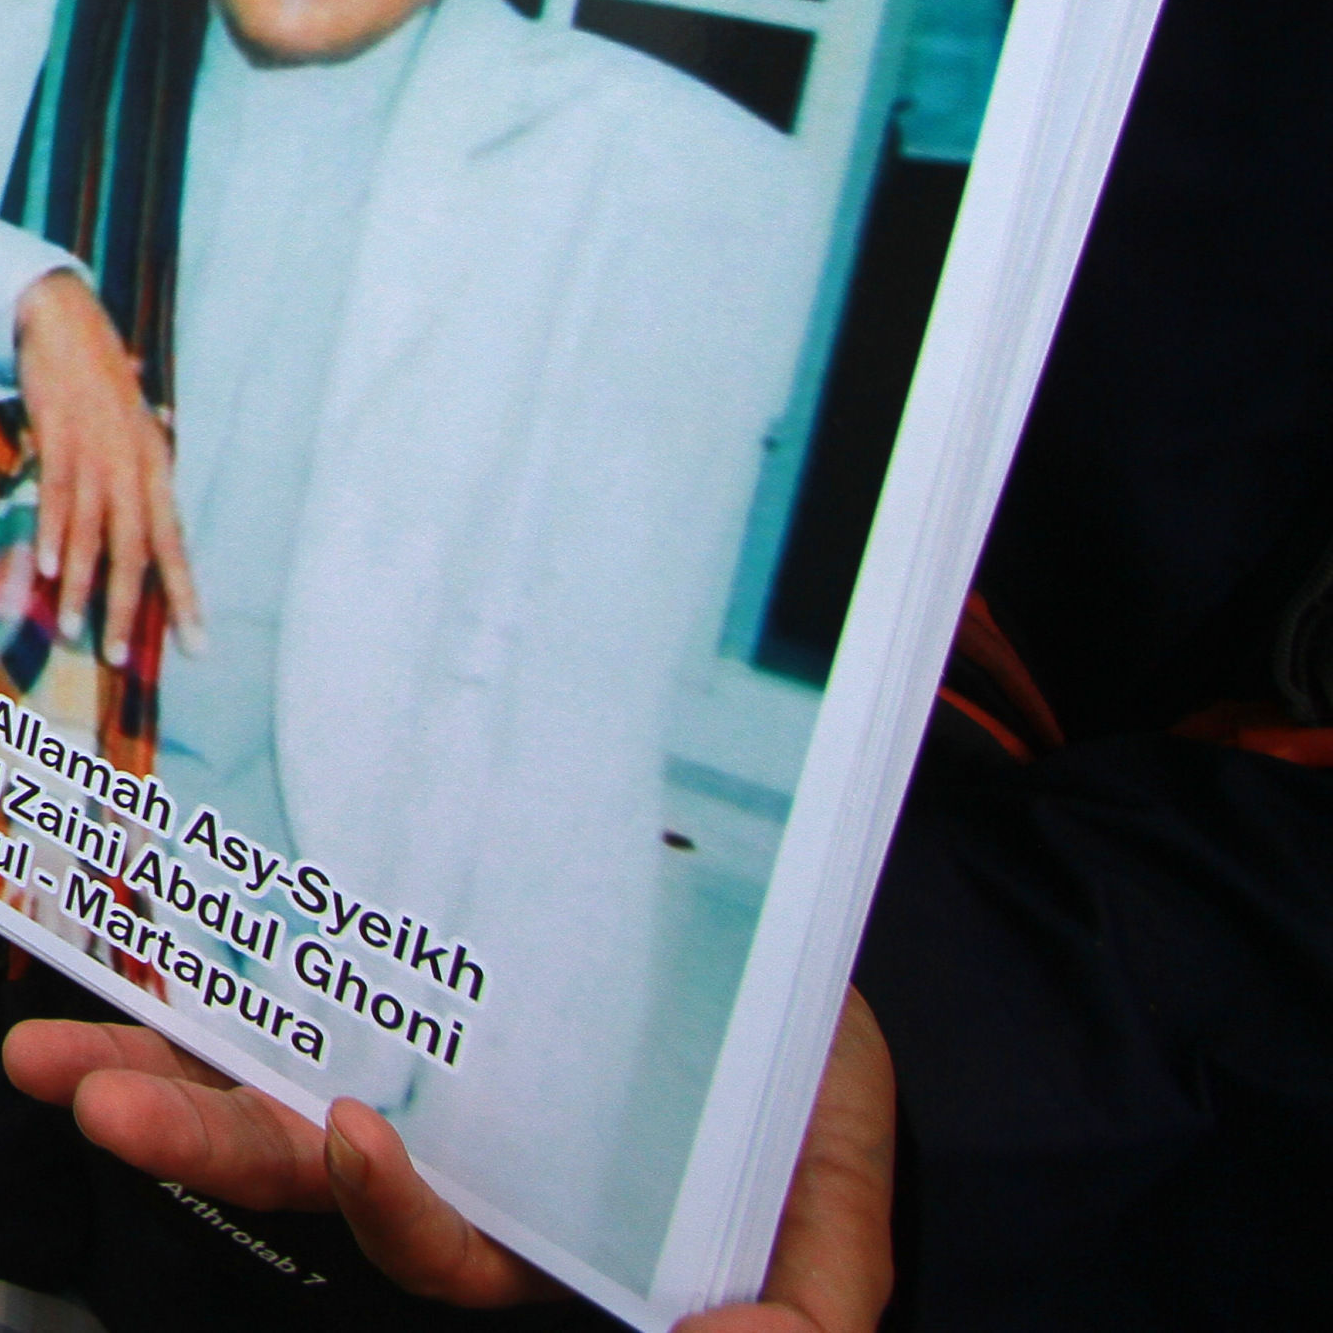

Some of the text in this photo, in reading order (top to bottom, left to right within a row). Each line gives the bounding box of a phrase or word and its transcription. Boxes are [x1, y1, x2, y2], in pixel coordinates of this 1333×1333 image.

[8, 774, 121, 869] Zaini
[129, 850, 280, 961] Abdul
[294, 941, 464, 1066] Ghoni
[64, 873, 325, 1063] Martapura
[183, 810, 484, 1002] Asy-Syeikh
[158, 1180, 297, 1274] Arthrotab
